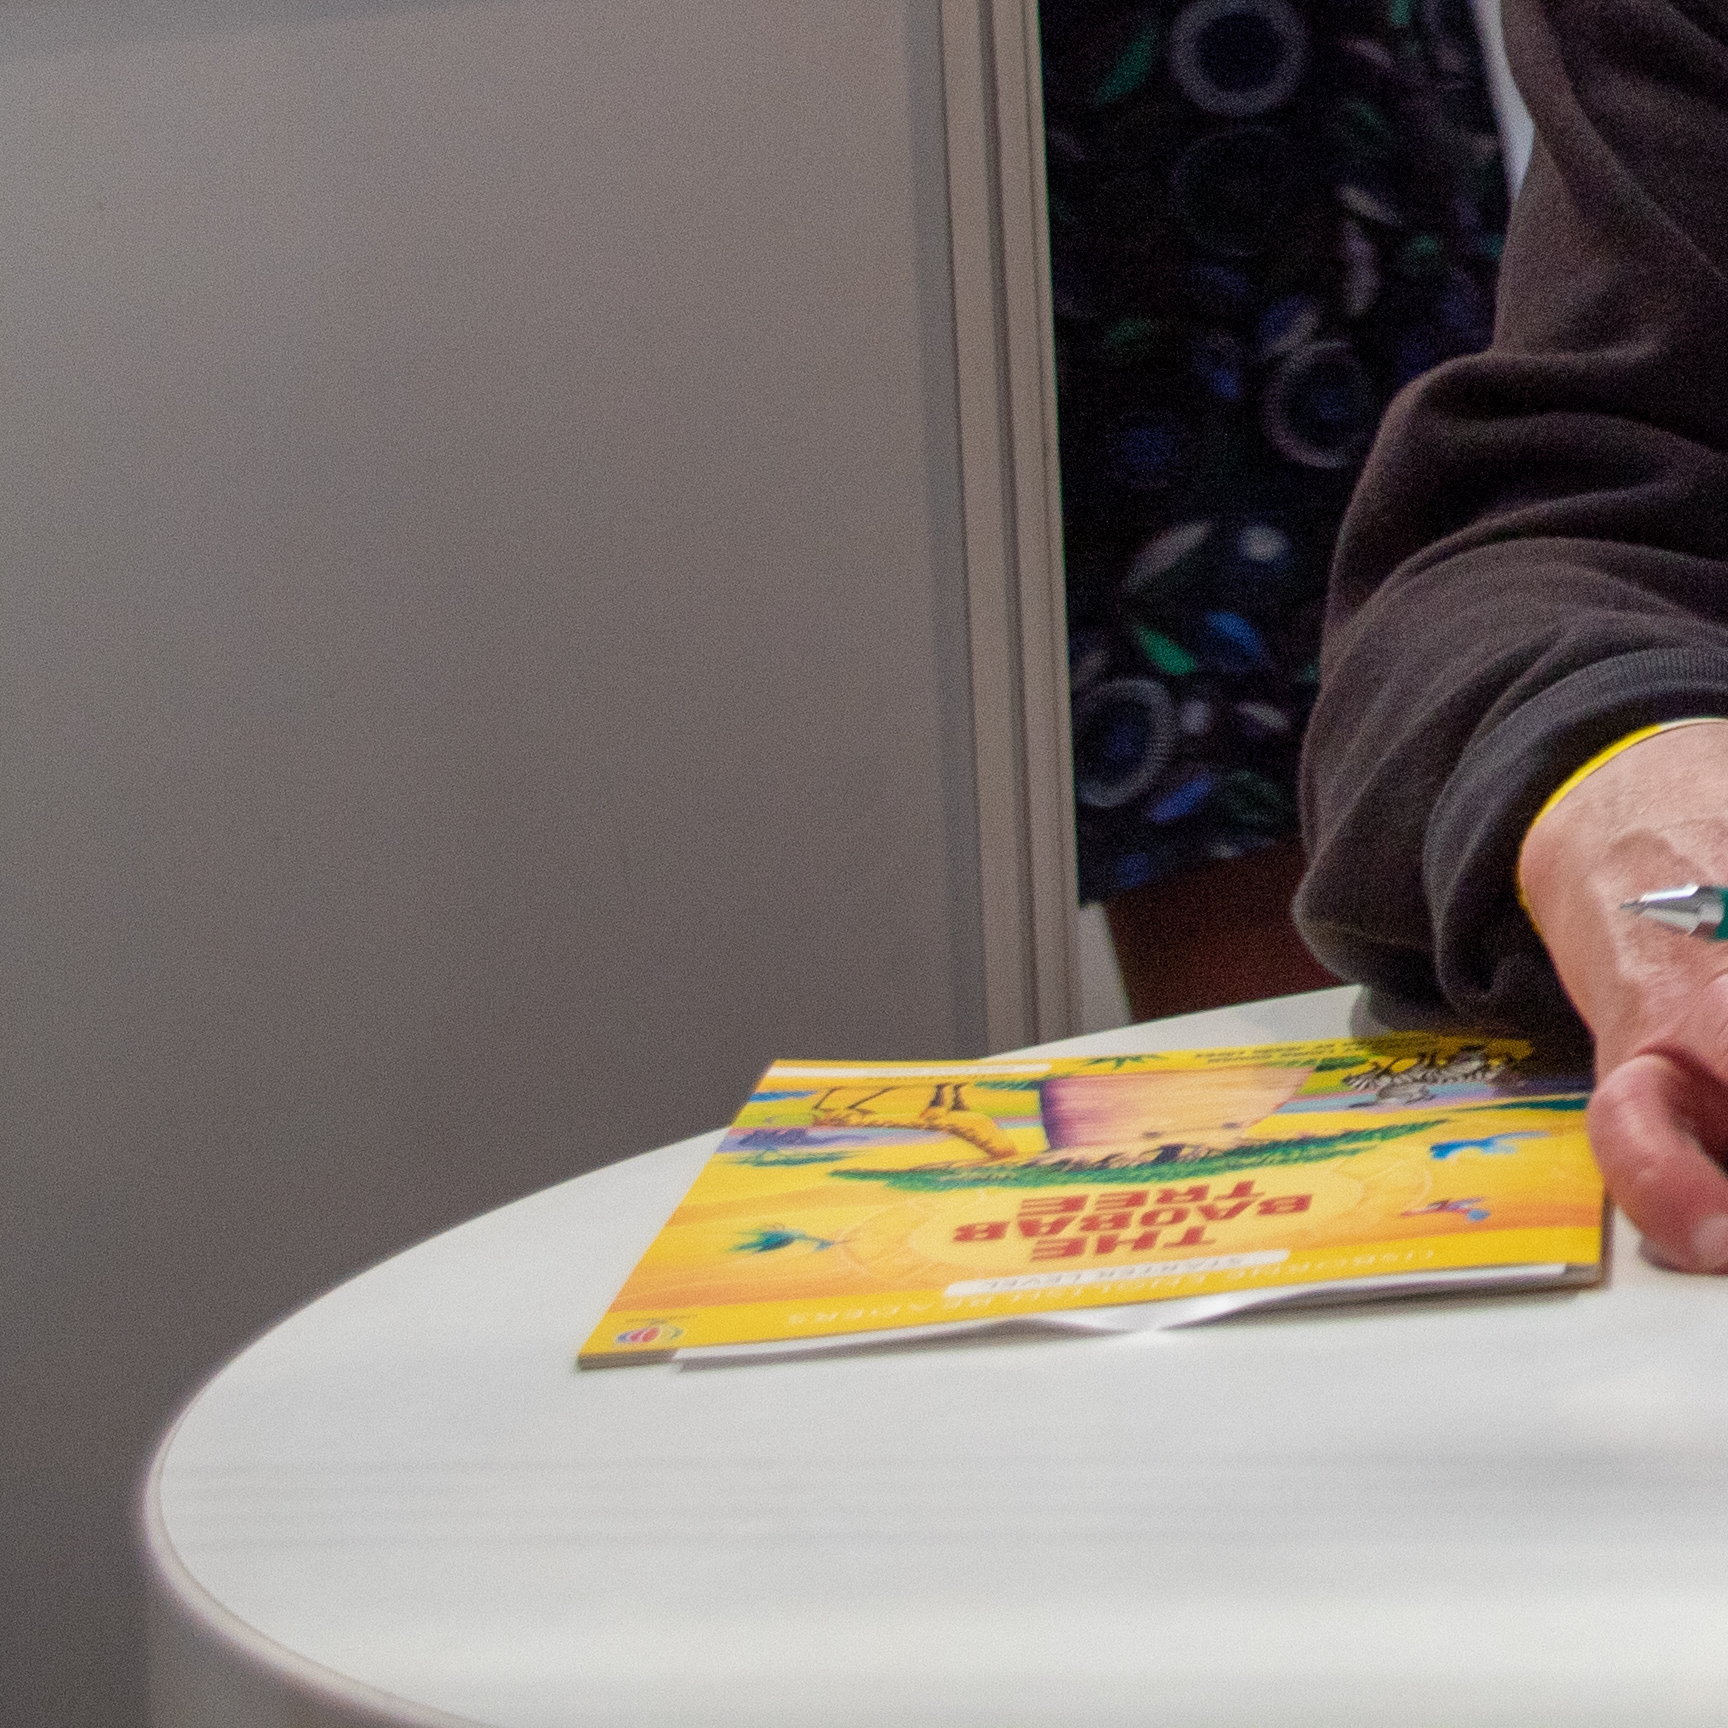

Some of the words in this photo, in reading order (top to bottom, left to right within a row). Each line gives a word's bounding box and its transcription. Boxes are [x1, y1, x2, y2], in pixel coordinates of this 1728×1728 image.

[952, 1192, 1314, 1244] BAOBAB
[1016, 1179, 1266, 1219] TREE
[1029, 1225, 1217, 1263] THE
